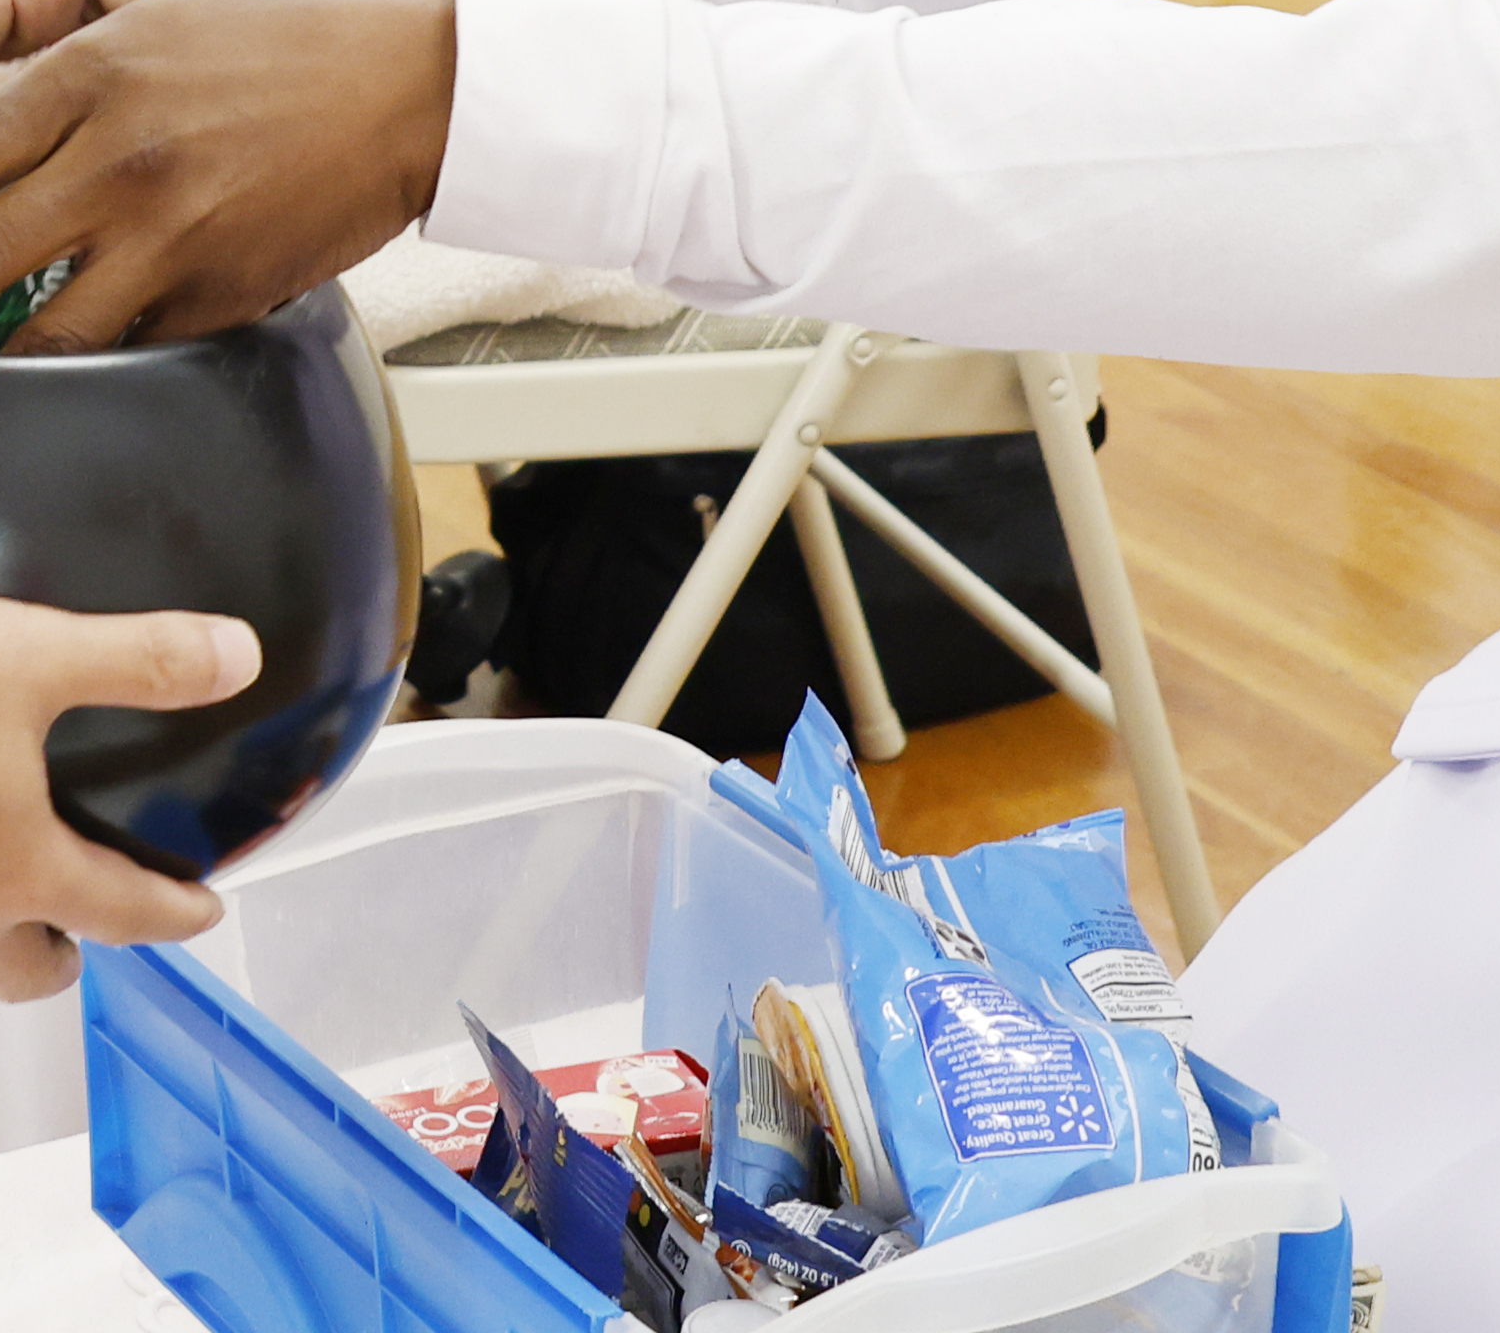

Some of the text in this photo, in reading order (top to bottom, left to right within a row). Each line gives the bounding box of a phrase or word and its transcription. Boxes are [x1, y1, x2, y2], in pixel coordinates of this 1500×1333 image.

[963, 1099, 1046, 1120] Guaranteed.
[972, 1114, 1050, 1130] Great Price.
[962, 1129, 1055, 1149] Great Quality.
[767, 1252, 799, 1276] (42g)
